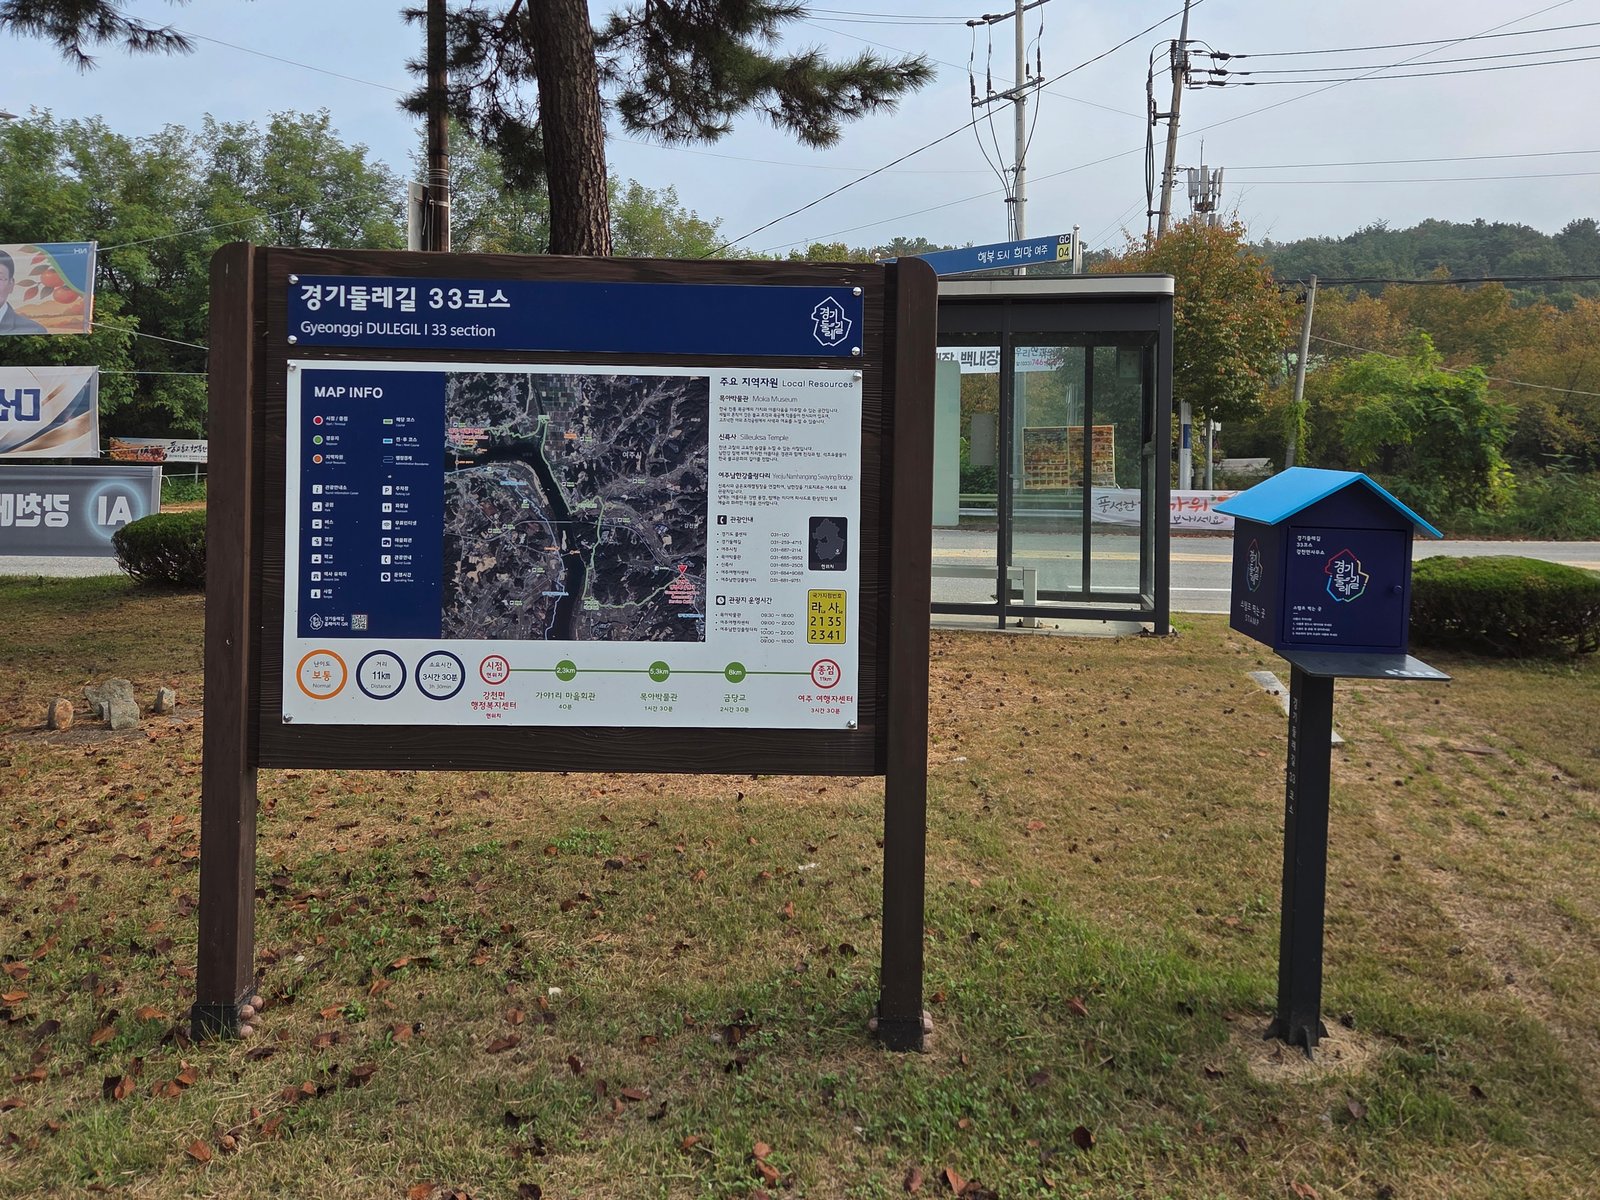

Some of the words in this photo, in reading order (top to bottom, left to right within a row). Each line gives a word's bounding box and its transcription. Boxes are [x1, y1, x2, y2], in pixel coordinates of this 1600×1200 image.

[1058, 234, 1070, 244] GC
[977, 252, 995, 264] 행복
[997, 250, 1010, 260] 도시
[1013, 246, 1032, 259] 희망
[1034, 244, 1048, 255] 여주
[1058, 247, 1069, 258] 04
[300, 284, 416, 312] 경기둘레길
[428, 287, 511, 310] 33코스
[300, 320, 363, 337] Gyeonggi
[366, 321, 422, 335] DULEGIL
[431, 323, 447, 336] 33
[450, 323, 496, 337] section
[960, 350, 1001, 367] 백내장
[719, 377, 738, 387] 주요
[741, 377, 778, 389] 지역자원
[782, 380, 806, 388] Local
[808, 380, 853, 388] Resources
[314, 386, 346, 398] MAP
[349, 386, 384, 399] INFO
[1096, 495, 1136, 514] 풍성한
[730, 516, 754, 524] 관광안내
[1171, 514, 1224, 526] 보내세요
[1296, 535, 1322, 543] 경기둘레길
[728, 596, 747, 605] 관광지
[748, 596, 773, 605] 운영시간
[811, 601, 822, 614] 라
[828, 602, 839, 614] 사
[810, 616, 842, 627] 2135
[810, 629, 841, 640] 2341
[486, 661, 503, 671] 시점
[817, 665, 834, 676] 종점
[312, 671, 332, 681] 보통
[372, 671, 391, 680] 11km
[422, 673, 441, 682] 3시간
[441, 673, 458, 682] 30분
[482, 691, 506, 700] 강천면
[535, 691, 562, 700] 가야1리
[565, 692, 596, 701] 마을회관
[639, 692, 678, 702] 목아박물관
[723, 694, 747, 703] 금당교
[797, 695, 813, 703] 여주
[815, 695, 853, 704] 여행자센터
[470, 701, 517, 710] 행정복지센터
